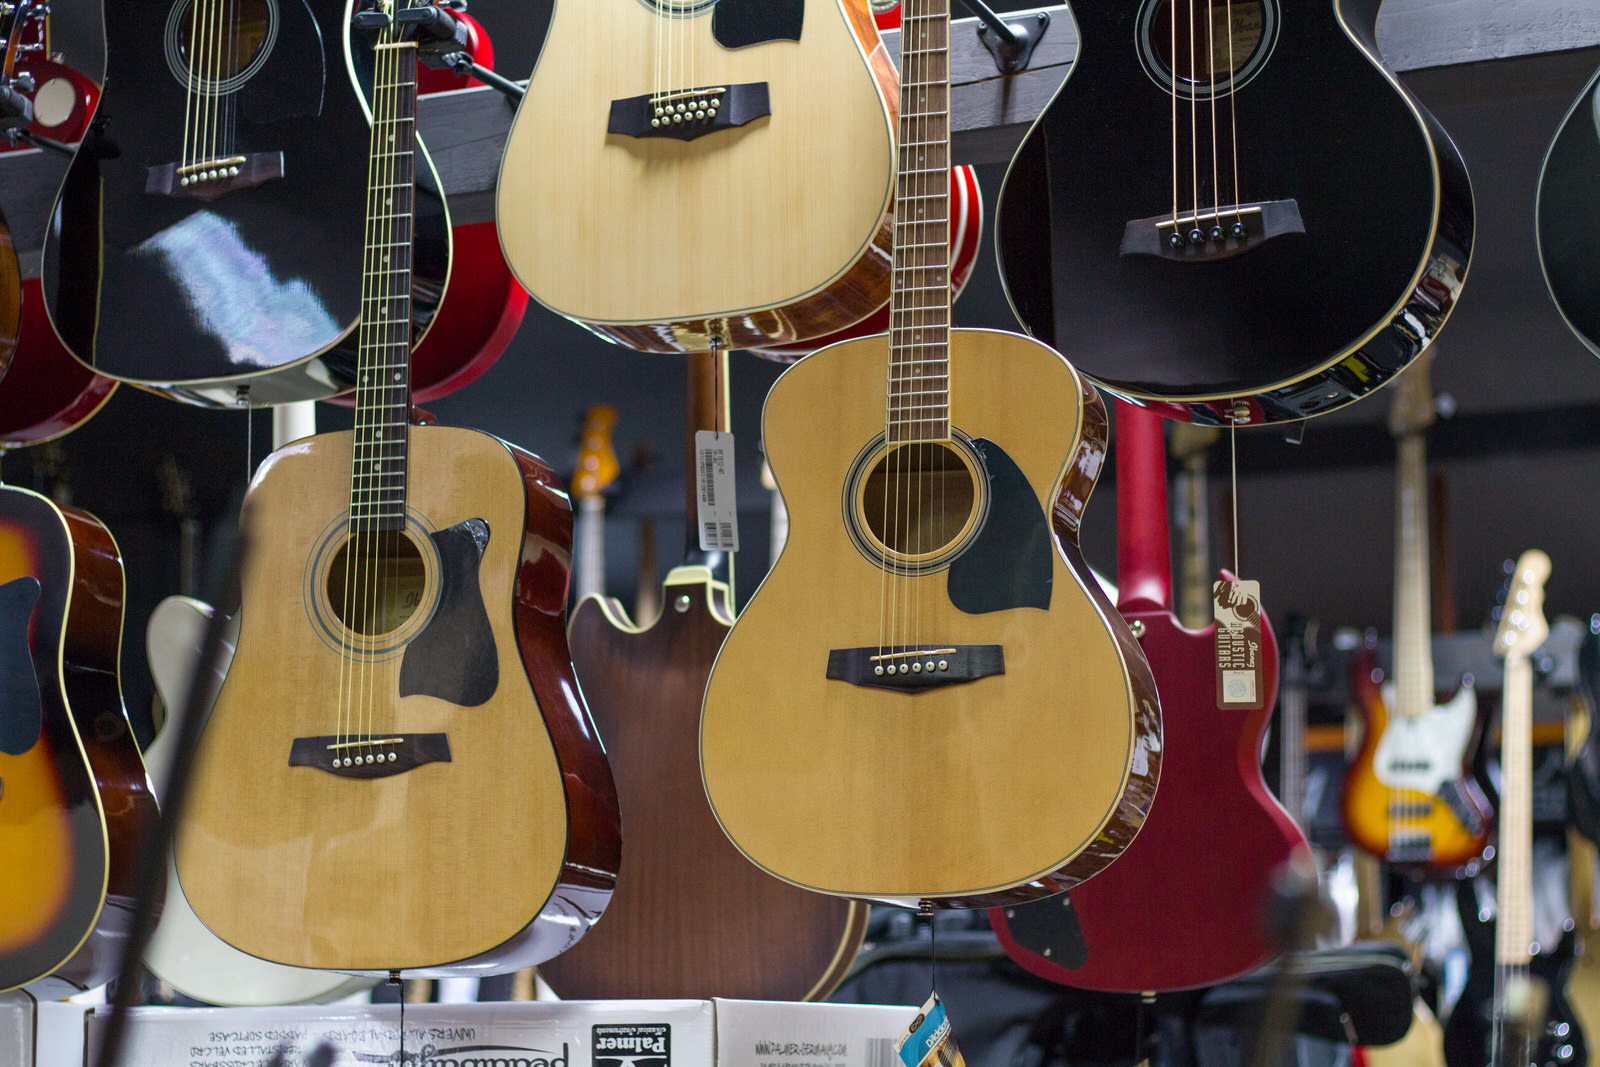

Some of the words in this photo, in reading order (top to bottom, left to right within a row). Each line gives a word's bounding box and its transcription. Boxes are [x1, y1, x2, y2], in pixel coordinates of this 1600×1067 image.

[1217, 627, 1231, 668] GUITARS
[1231, 622, 1245, 668] ACOUSTIC
[1247, 640, 1258, 668] Ibanez
[208, 1031, 263, 1042] SOFTCASE
[409, 1028, 476, 1042] UNIVERSAL
[190, 1047, 230, 1058] VELCRO
[596, 1037, 667, 1053] Palmer
